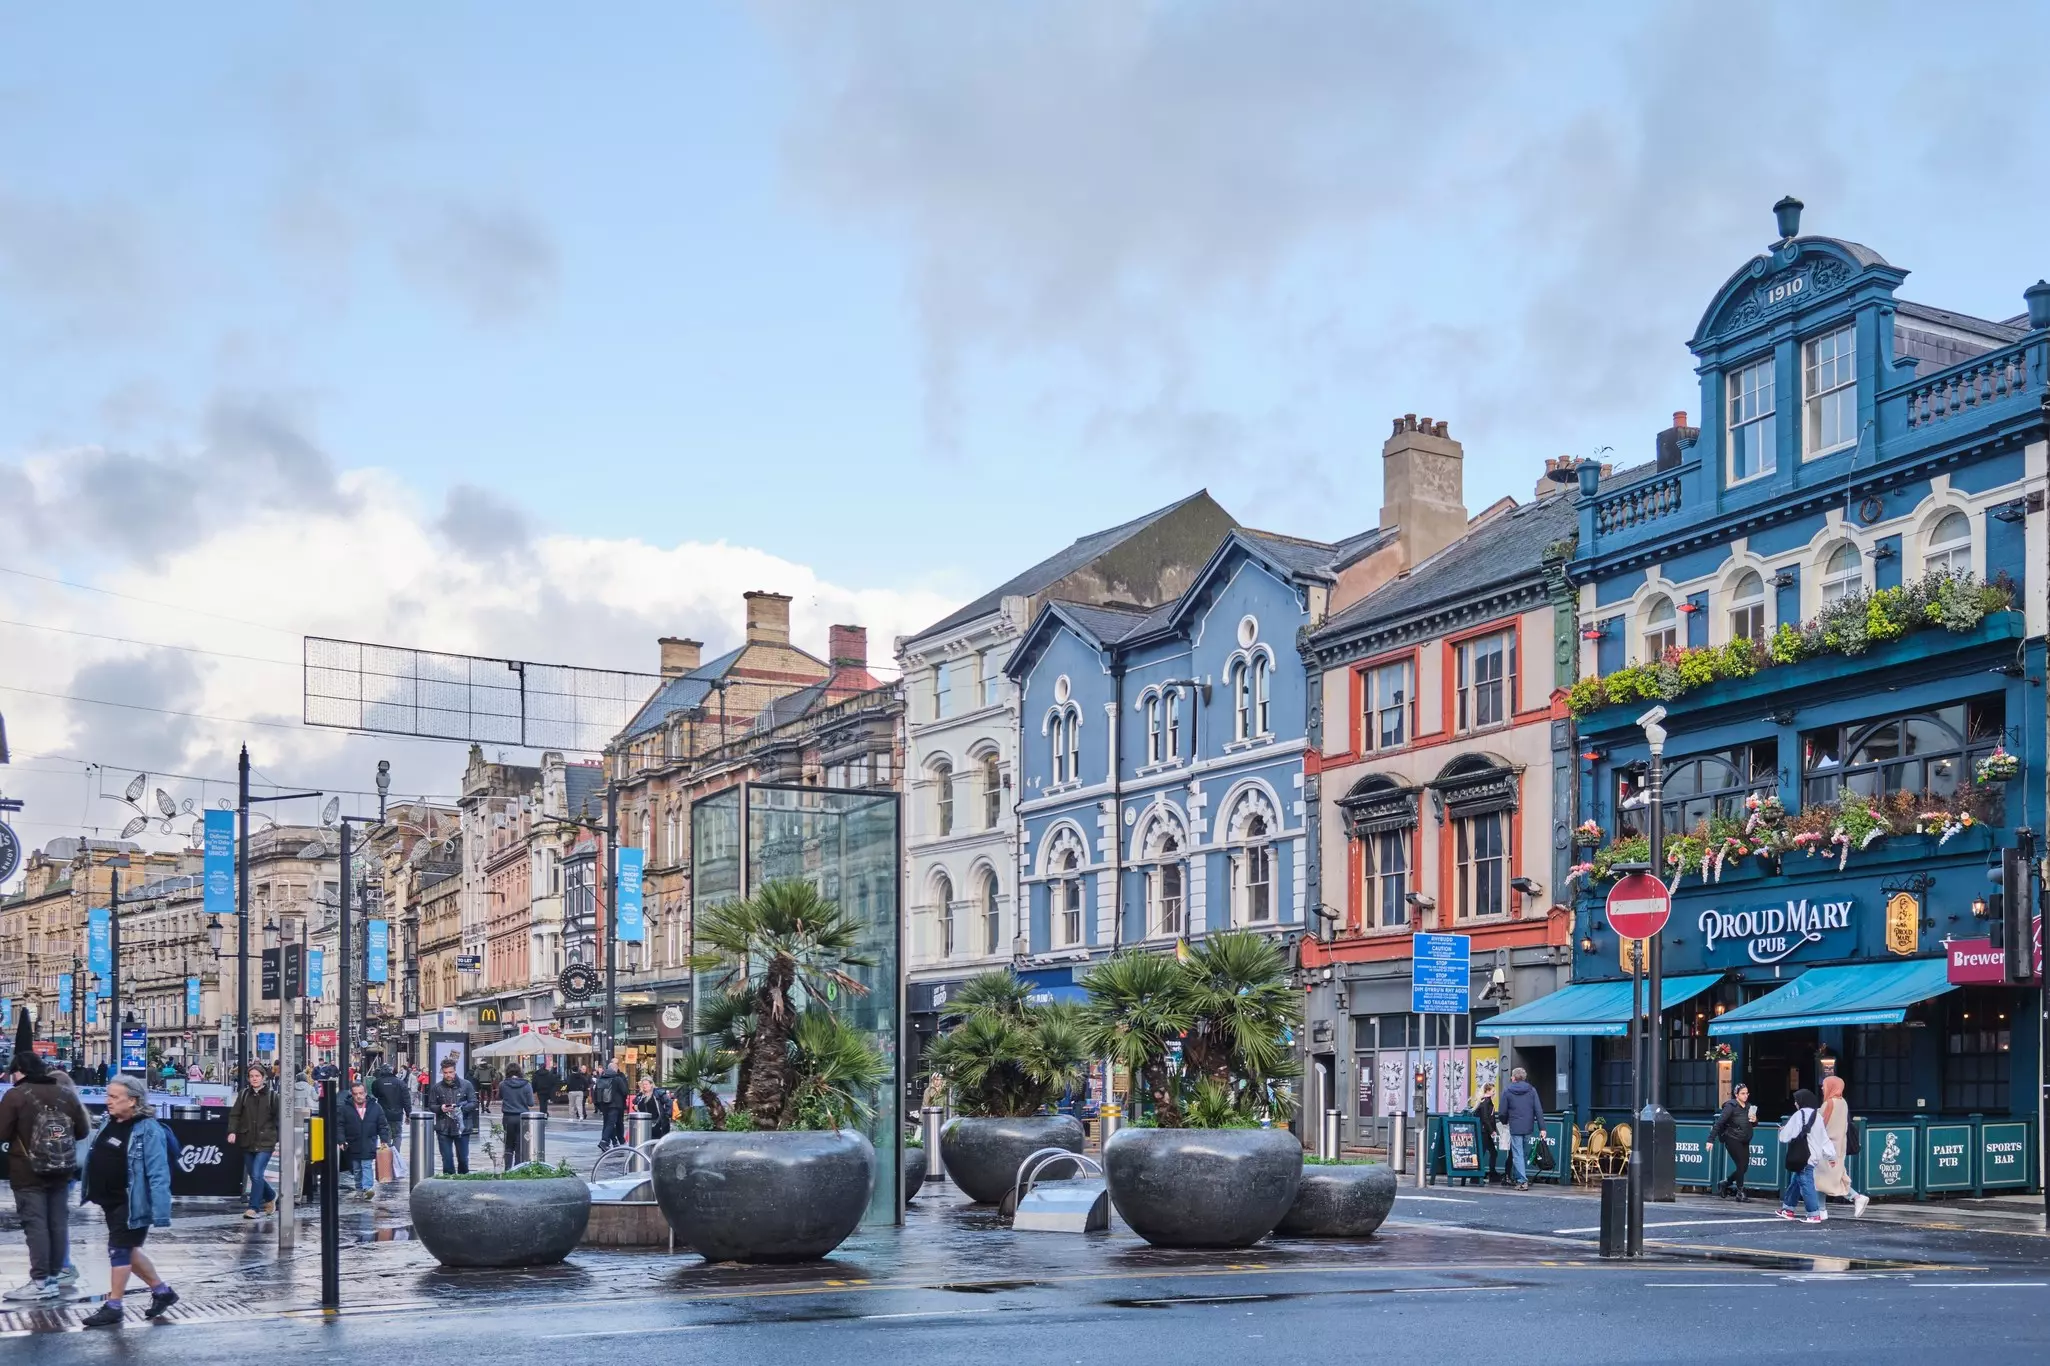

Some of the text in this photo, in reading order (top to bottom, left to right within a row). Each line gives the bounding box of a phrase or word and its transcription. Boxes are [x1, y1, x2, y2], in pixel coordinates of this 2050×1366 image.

[1769, 278, 1803, 303] 1910
[1698, 899, 1853, 951] PROUD MARY
[1757, 937, 1787, 953] PUB
[1675, 1142, 1700, 1151] BEER
[1748, 1145, 1764, 1154] IVE
[1933, 1145, 1964, 1155] PARTY
[1986, 1142, 2022, 1153] SPORTS
[1679, 1154, 1703, 1163] FOOD
[1748, 1157, 1768, 1166] SIC
[1938, 1157, 1959, 1167] PUB
[1994, 1154, 2015, 1164] BAR
[1879, 1164, 1902, 1175] PROUD
